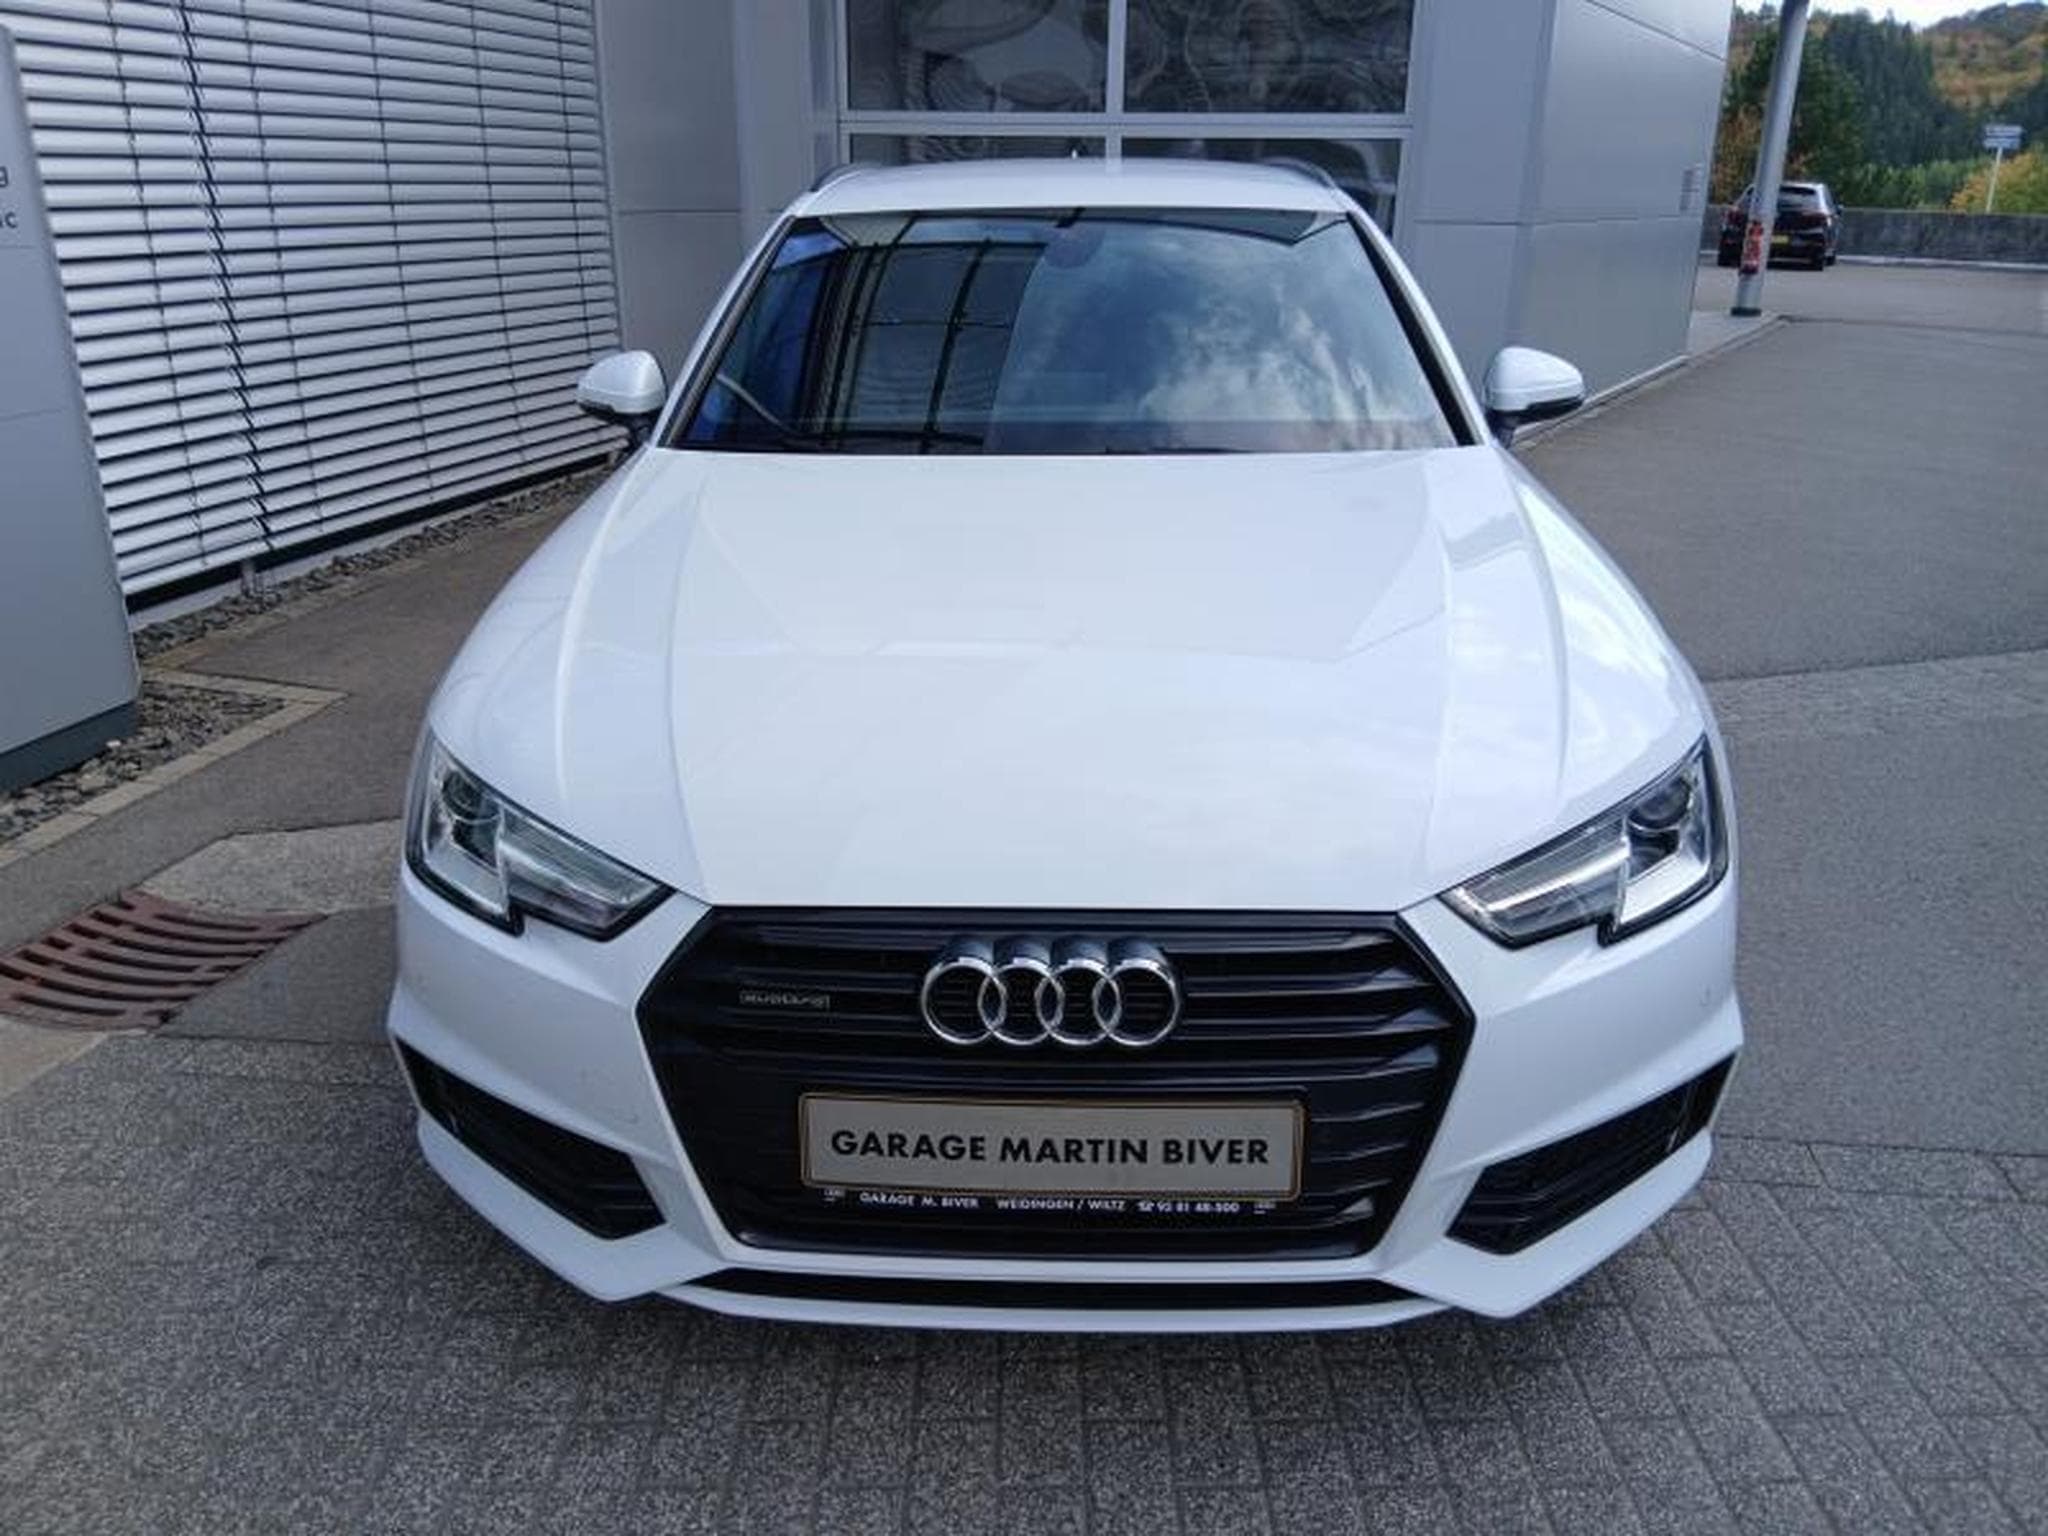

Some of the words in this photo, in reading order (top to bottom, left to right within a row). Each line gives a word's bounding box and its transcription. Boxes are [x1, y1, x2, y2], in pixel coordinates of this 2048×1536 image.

[831, 1129, 986, 1161] GARAGE
[999, 1136, 1149, 1164] MARTIN
[1162, 1138, 1269, 1165] BIVER
[859, 1191, 915, 1207] GARAGE
[941, 1197, 980, 1209] BIVER
